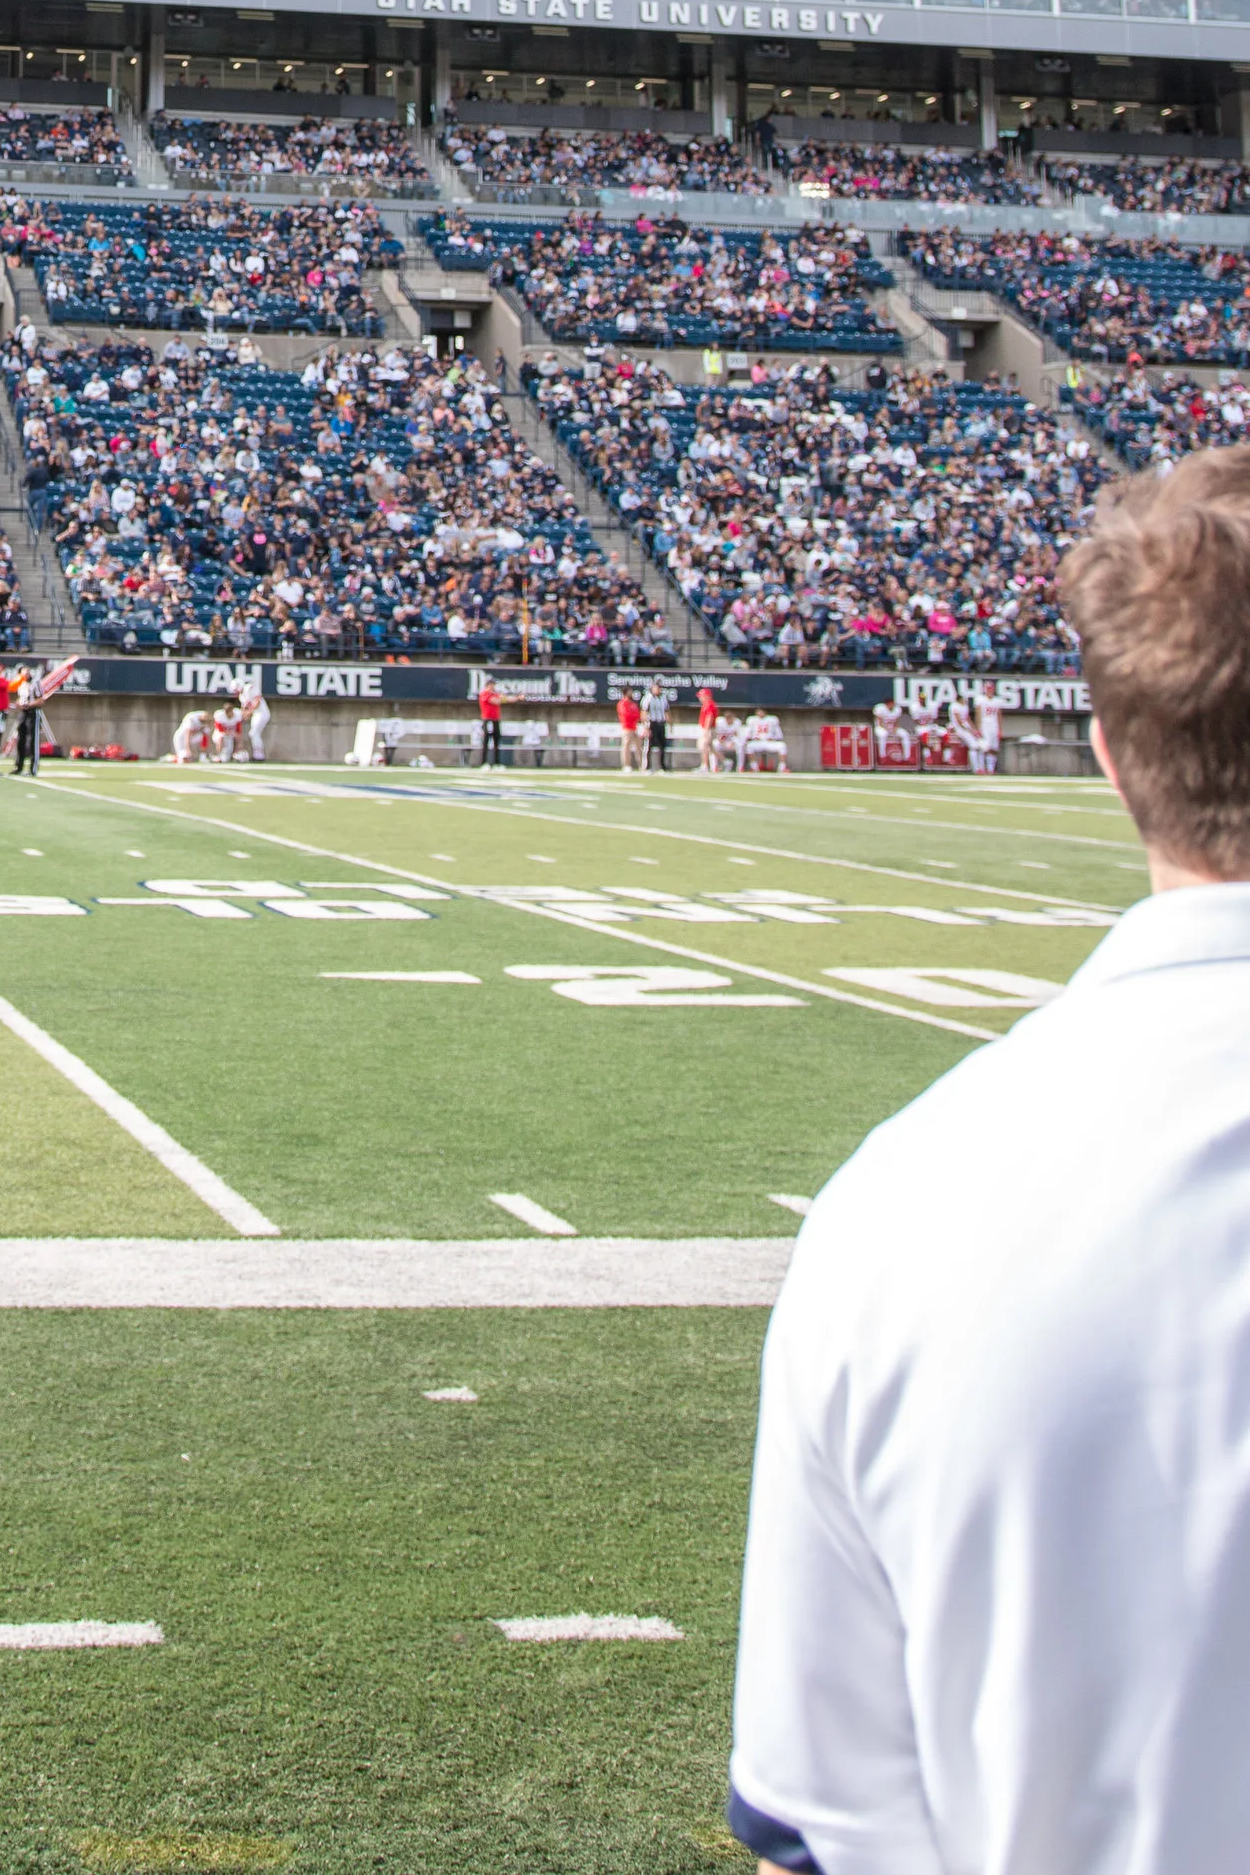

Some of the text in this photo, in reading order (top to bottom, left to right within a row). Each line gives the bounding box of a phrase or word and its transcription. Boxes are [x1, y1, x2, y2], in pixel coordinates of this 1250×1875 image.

[639, 0, 884, 36] UNIVERSITY
[165, 662, 382, 698] UTAH STATE
[554, 671, 597, 696] Tire
[607, 672, 652, 689] Serving
[692, 674, 729, 691] Valley
[607, 687, 642, 701] Sie
[893, 677, 1093, 711] UTAH STATE
[539, 904, 1122, 926] RLIN
